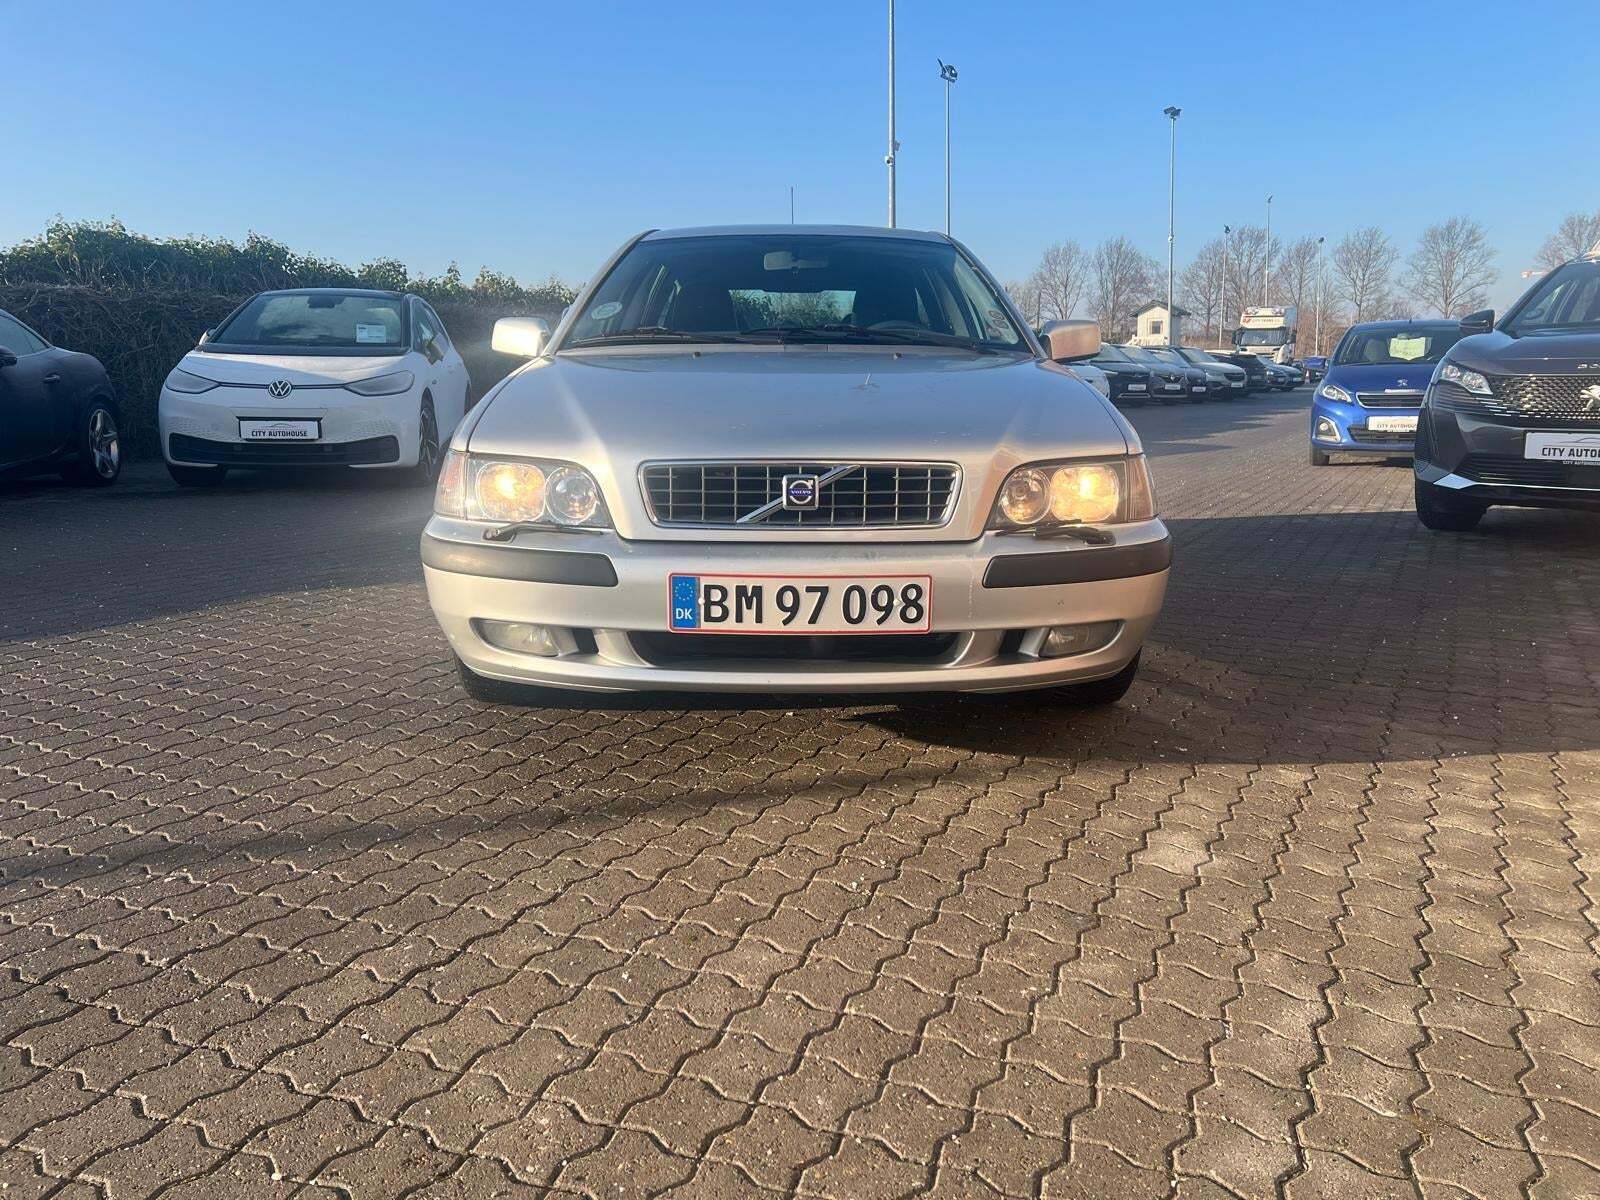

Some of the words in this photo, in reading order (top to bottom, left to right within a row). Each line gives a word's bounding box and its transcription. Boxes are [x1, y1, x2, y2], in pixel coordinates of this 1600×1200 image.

[1541, 447, 1565, 457] CITY
[703, 584, 763, 624] BM
[775, 585, 830, 626] 97
[842, 583, 925, 625] 098
[675, 608, 693, 620] DK
